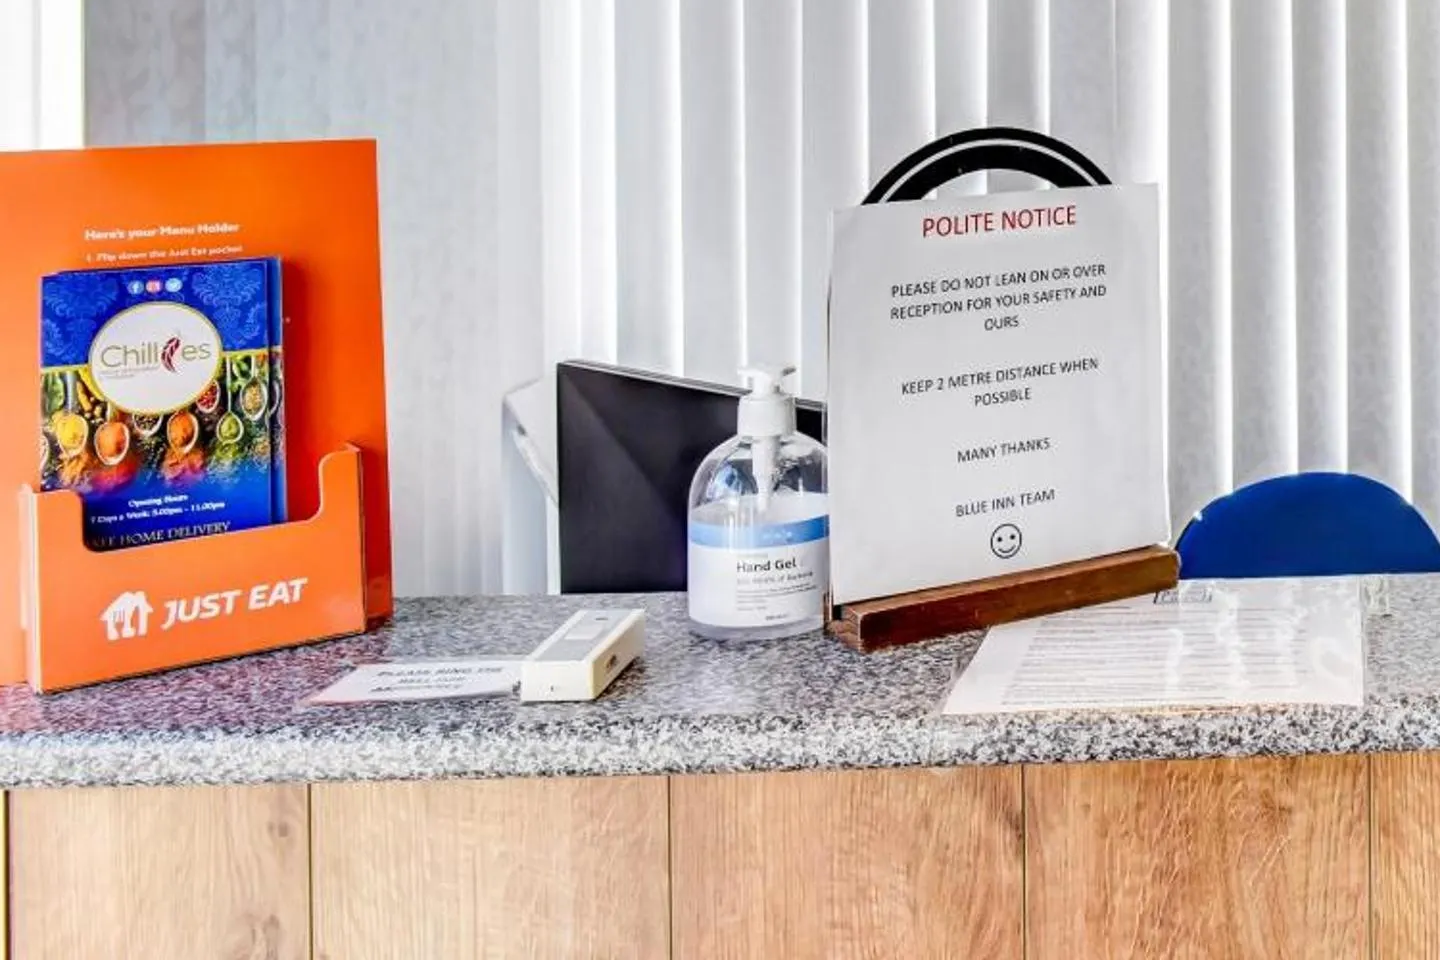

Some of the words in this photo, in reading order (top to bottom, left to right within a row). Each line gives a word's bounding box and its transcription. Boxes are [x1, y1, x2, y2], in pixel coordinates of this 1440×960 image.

[923, 212, 995, 238] POLITE
[1001, 205, 1077, 230] NOTICE
[892, 281, 937, 297] PLEASE
[941, 278, 961, 292] DO
[965, 275, 991, 289] NOT
[995, 272, 1026, 287] LEAN
[1030, 269, 1049, 282] ON
[1051, 268, 1070, 280] OR
[1073, 264, 1106, 278] OVER
[890, 301, 963, 319] RECEPTION
[967, 297, 992, 311] FOR
[995, 292, 1030, 308] YOUR
[1032, 287, 1077, 304] SAFETY
[1079, 284, 1107, 298] AND
[984, 315, 1019, 331] OURS
[902, 378, 934, 395] KEEP
[937, 377, 945, 390] 2
[948, 371, 992, 389] METRE
[996, 362, 1057, 383] DISTANCE
[1059, 357, 1099, 374] WHEN
[974, 387, 1032, 407] POSSIBLE
[957, 444, 998, 464] MANY
[1000, 437, 1051, 456] THANKS
[955, 501, 988, 518] BLUE
[991, 496, 1015, 511] INN
[1019, 489, 1056, 507] TEAM
[168, 520, 231, 539] DELIVERY
[736, 560, 771, 573] Hand
[775, 556, 797, 571] Gel
[160, 589, 243, 631] JUST
[248, 577, 309, 611] EAT
